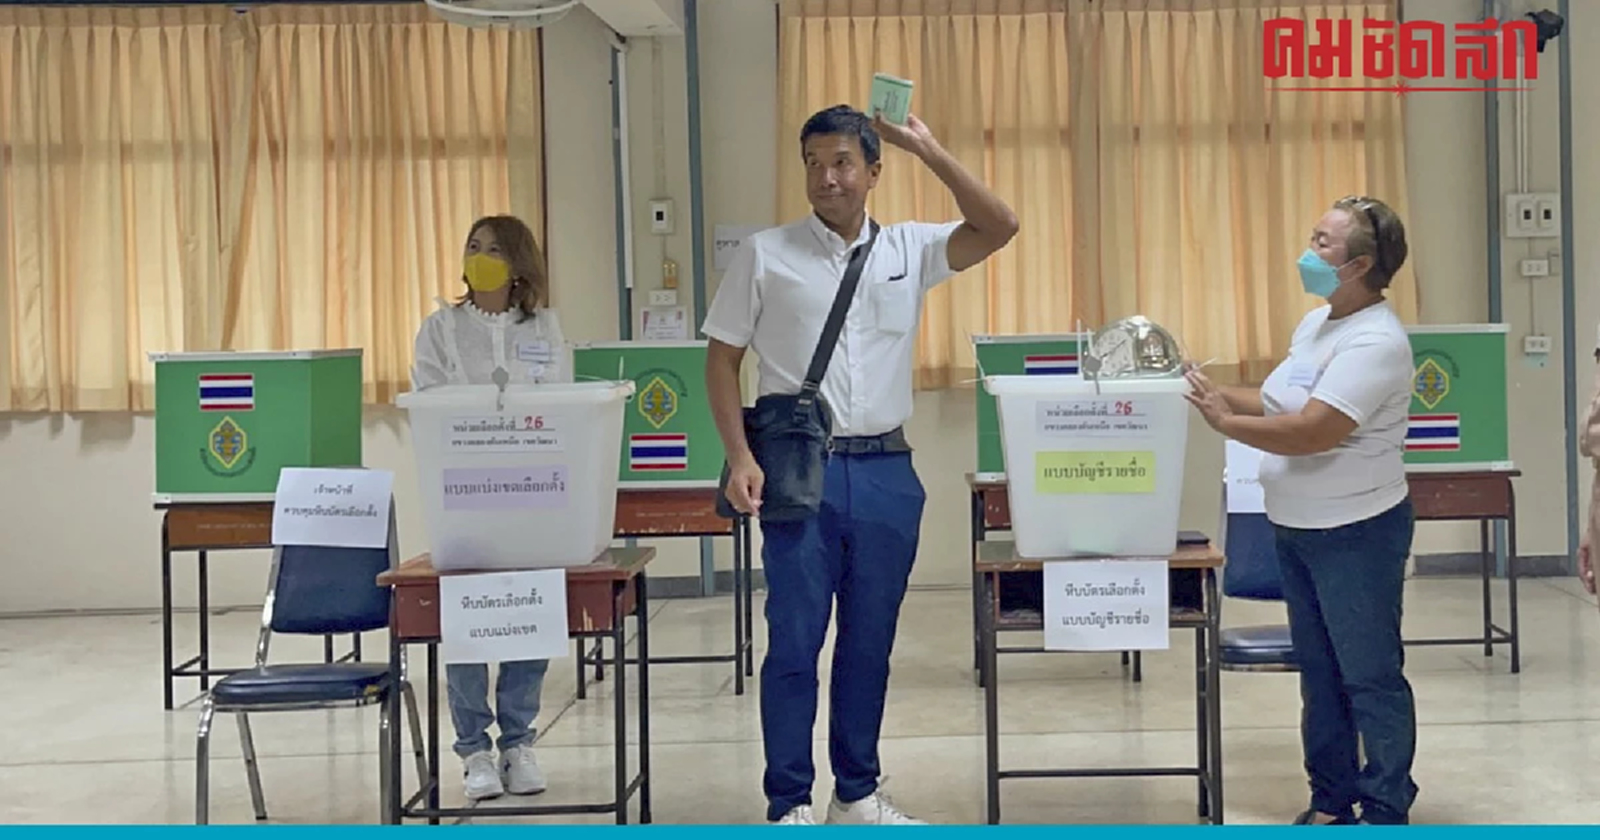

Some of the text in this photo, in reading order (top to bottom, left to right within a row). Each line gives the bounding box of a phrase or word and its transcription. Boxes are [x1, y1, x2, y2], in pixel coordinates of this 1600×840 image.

[1114, 400, 1133, 416] 26
[524, 416, 544, 430] 26
[1044, 457, 1146, 481] แบบบัญชีรายชื่อ
[314, 484, 353, 495] เจ้าหน้าที่
[444, 472, 565, 495] แบบแบ่งเขตเลือกตั้ง
[284, 504, 378, 518] ควบคุมหีบบัตรเลือกตั้ง
[1065, 578, 1146, 597] หีบบัตรเลือกตั้ง
[461, 588, 543, 609] หีบบัตรเลือกตั้ง
[1062, 608, 1150, 629] แบบบัญชีรายชื่อ
[469, 623, 538, 639] แบบแบ่งเขต
